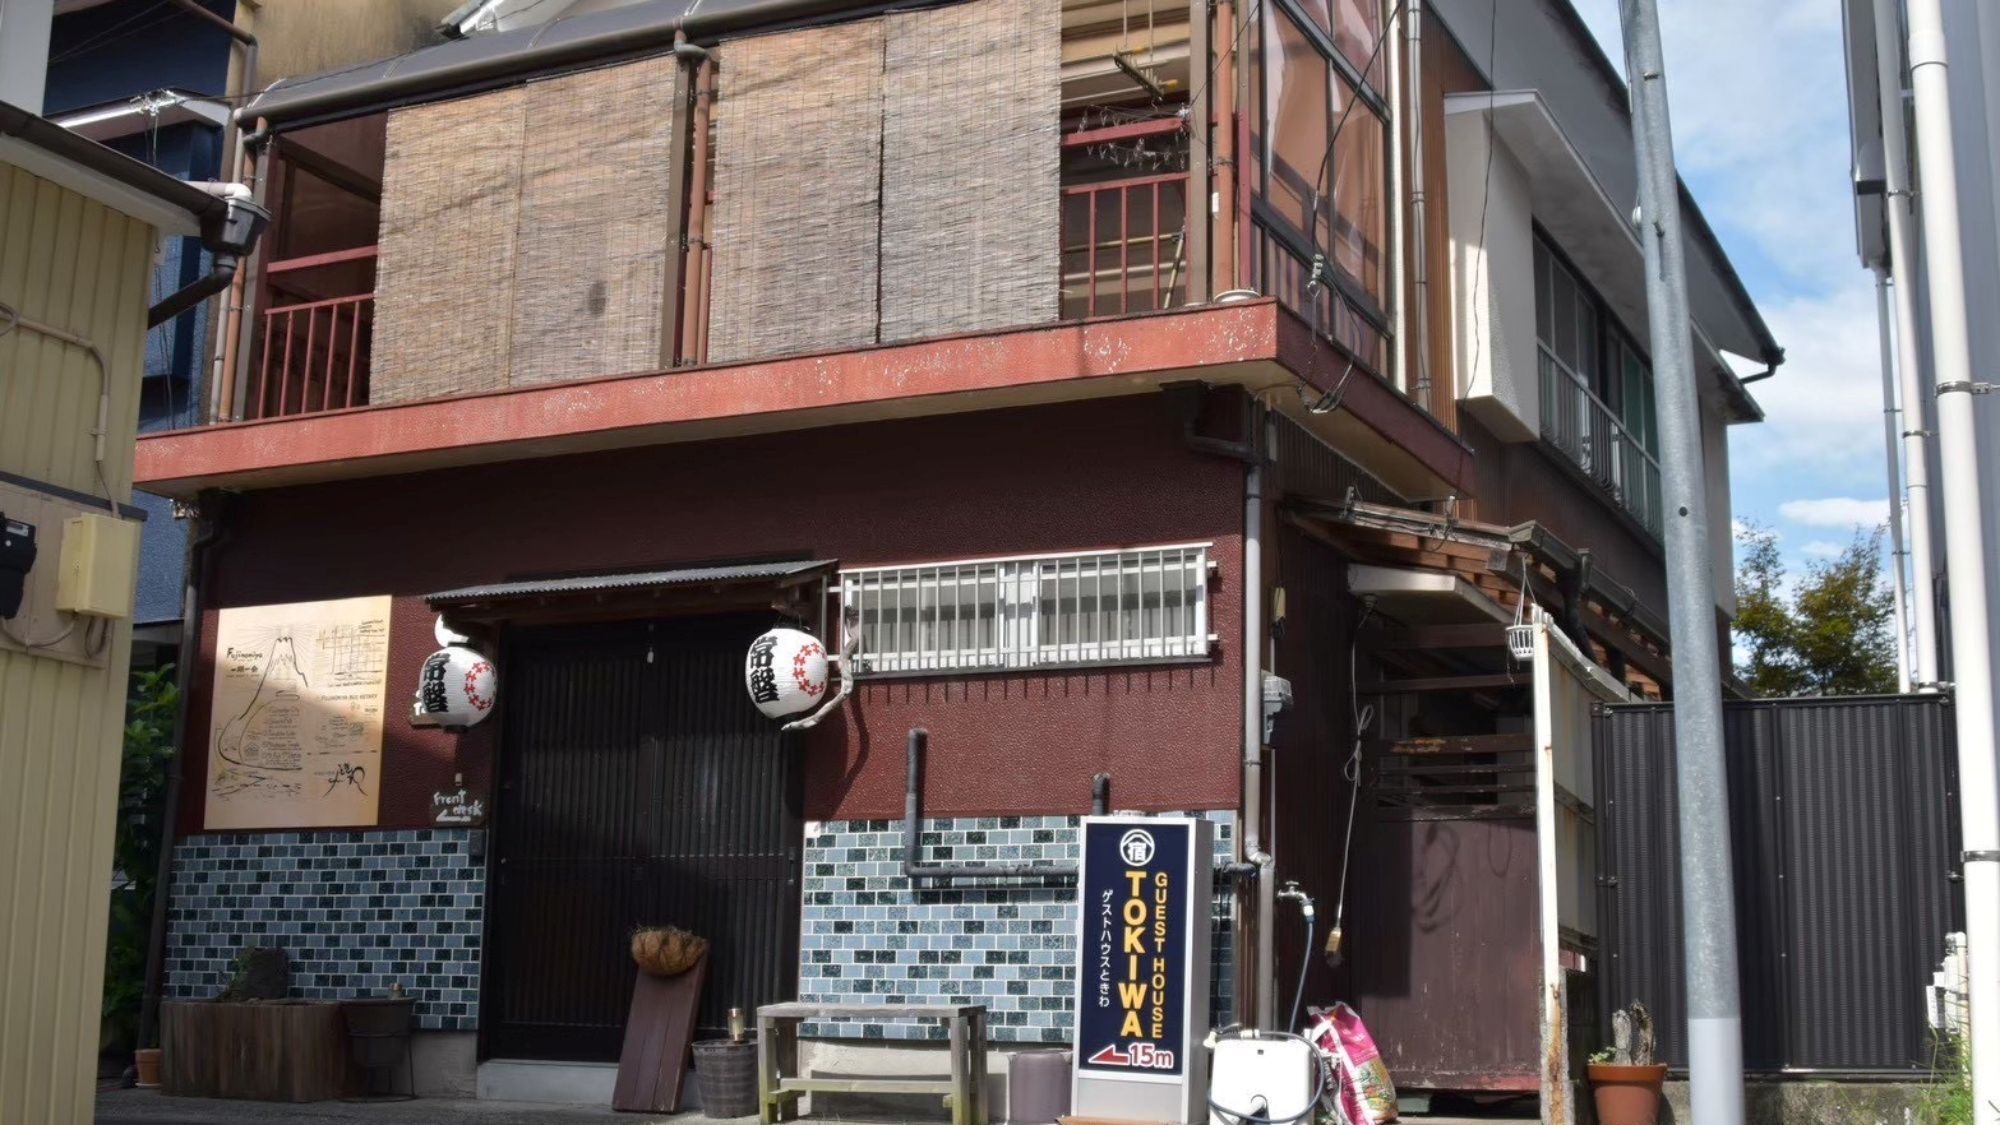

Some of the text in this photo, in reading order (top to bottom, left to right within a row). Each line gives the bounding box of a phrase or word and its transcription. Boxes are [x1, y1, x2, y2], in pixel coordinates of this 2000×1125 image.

[227, 647, 263, 660] Fujinomiya
[1099, 889, 1113, 1008] ゲストハウスときわ
[1118, 871, 1148, 1037] TOKIWA
[1152, 872, 1168, 1039] GUEST HOUSE
[1129, 1042, 1174, 1069] 15m
